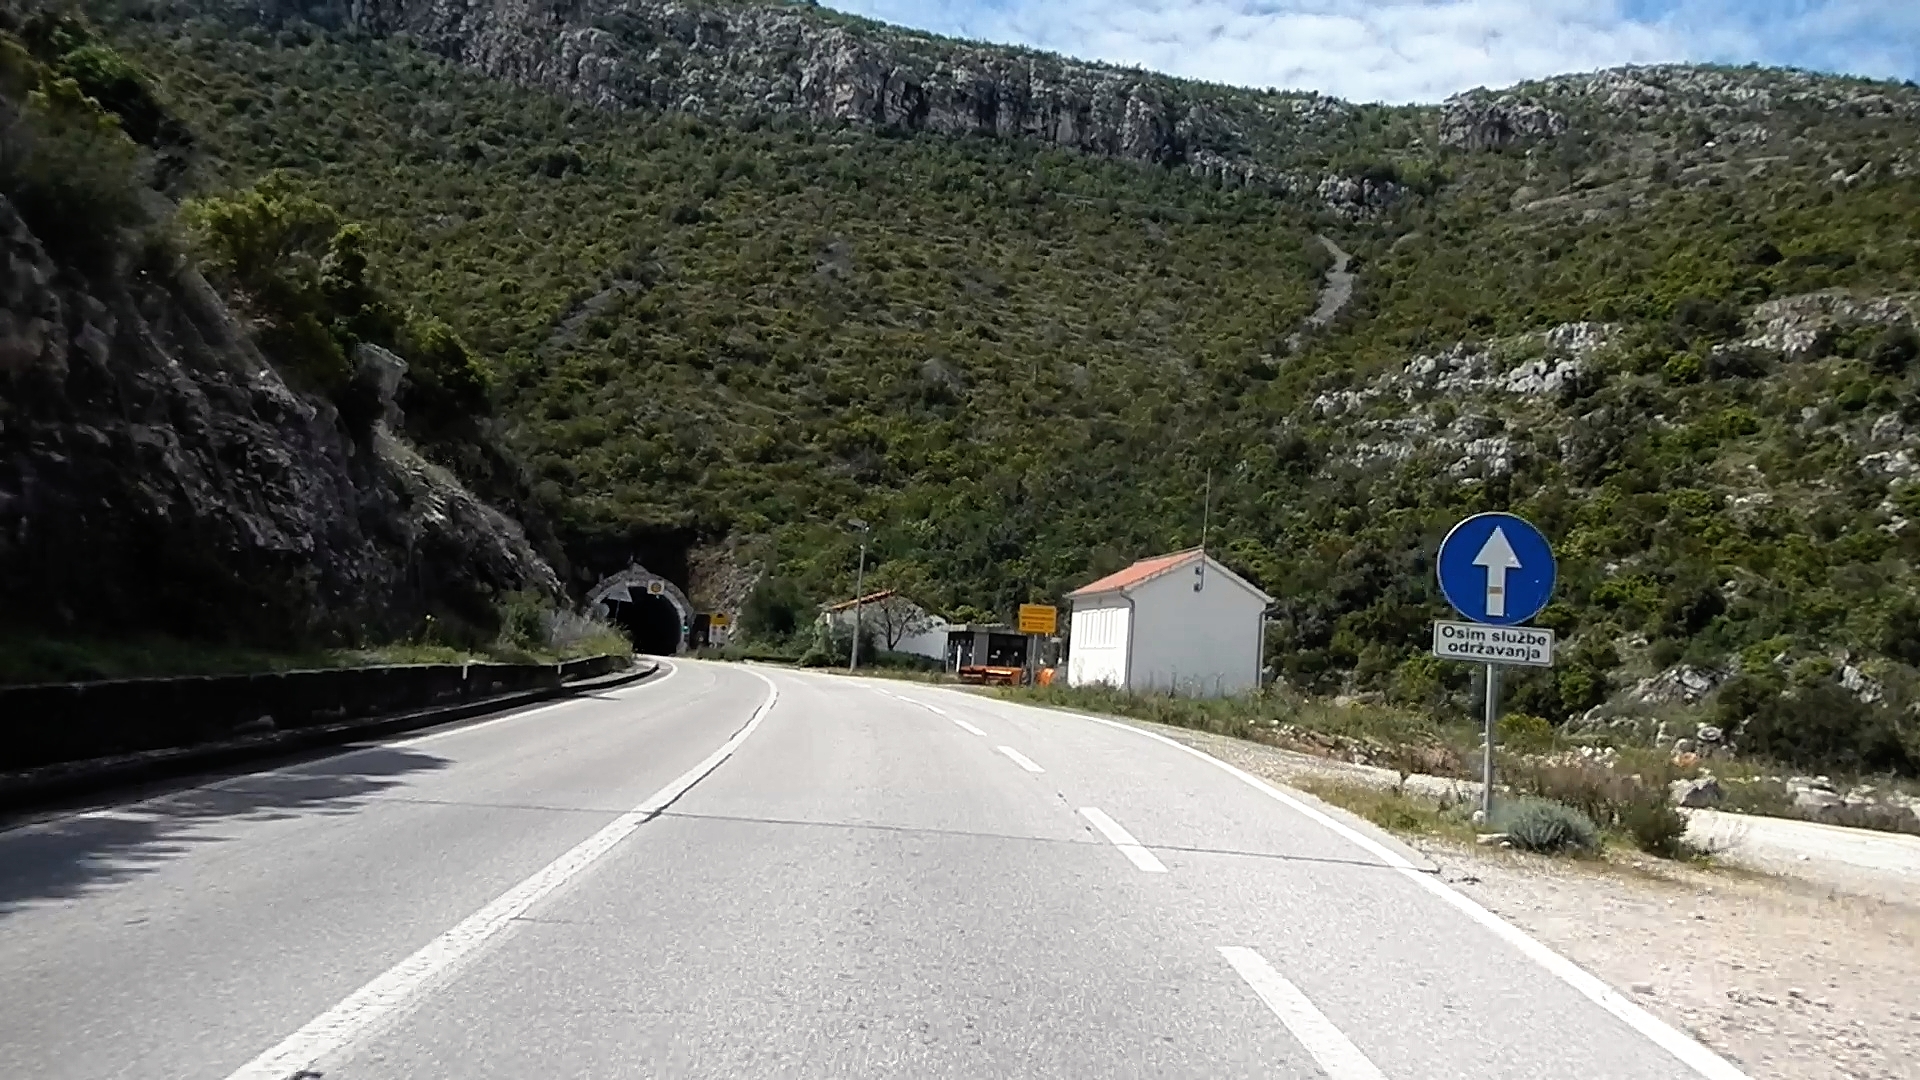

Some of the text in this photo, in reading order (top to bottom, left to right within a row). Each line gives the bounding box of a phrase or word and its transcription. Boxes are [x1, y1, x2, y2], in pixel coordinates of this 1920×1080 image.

[1442, 626, 1546, 646] Osim službe
[1448, 641, 1540, 661] održavanja
